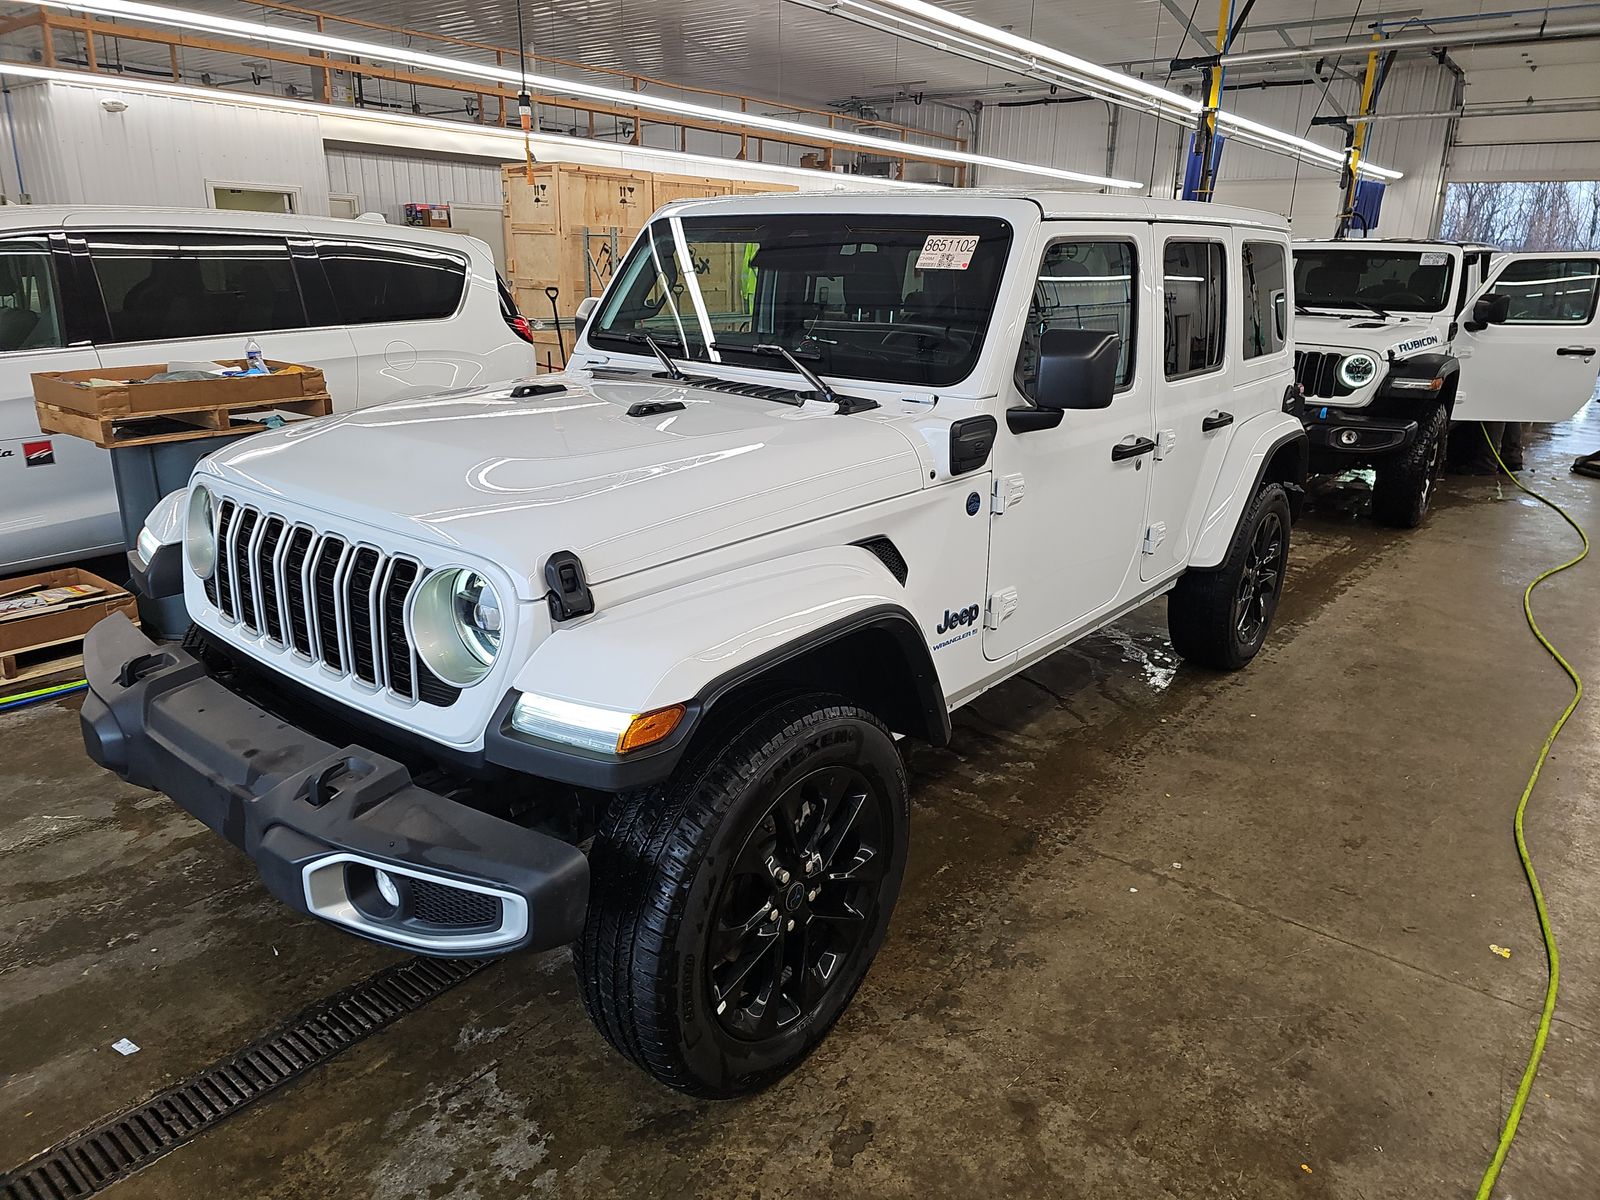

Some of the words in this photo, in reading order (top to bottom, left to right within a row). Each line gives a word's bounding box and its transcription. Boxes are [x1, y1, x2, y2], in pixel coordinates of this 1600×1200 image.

[924, 239, 977, 252] 8651102
[1398, 335, 1438, 352] RUBICON
[936, 603, 979, 635] Jeep
[932, 631, 971, 651] WRANGLER
